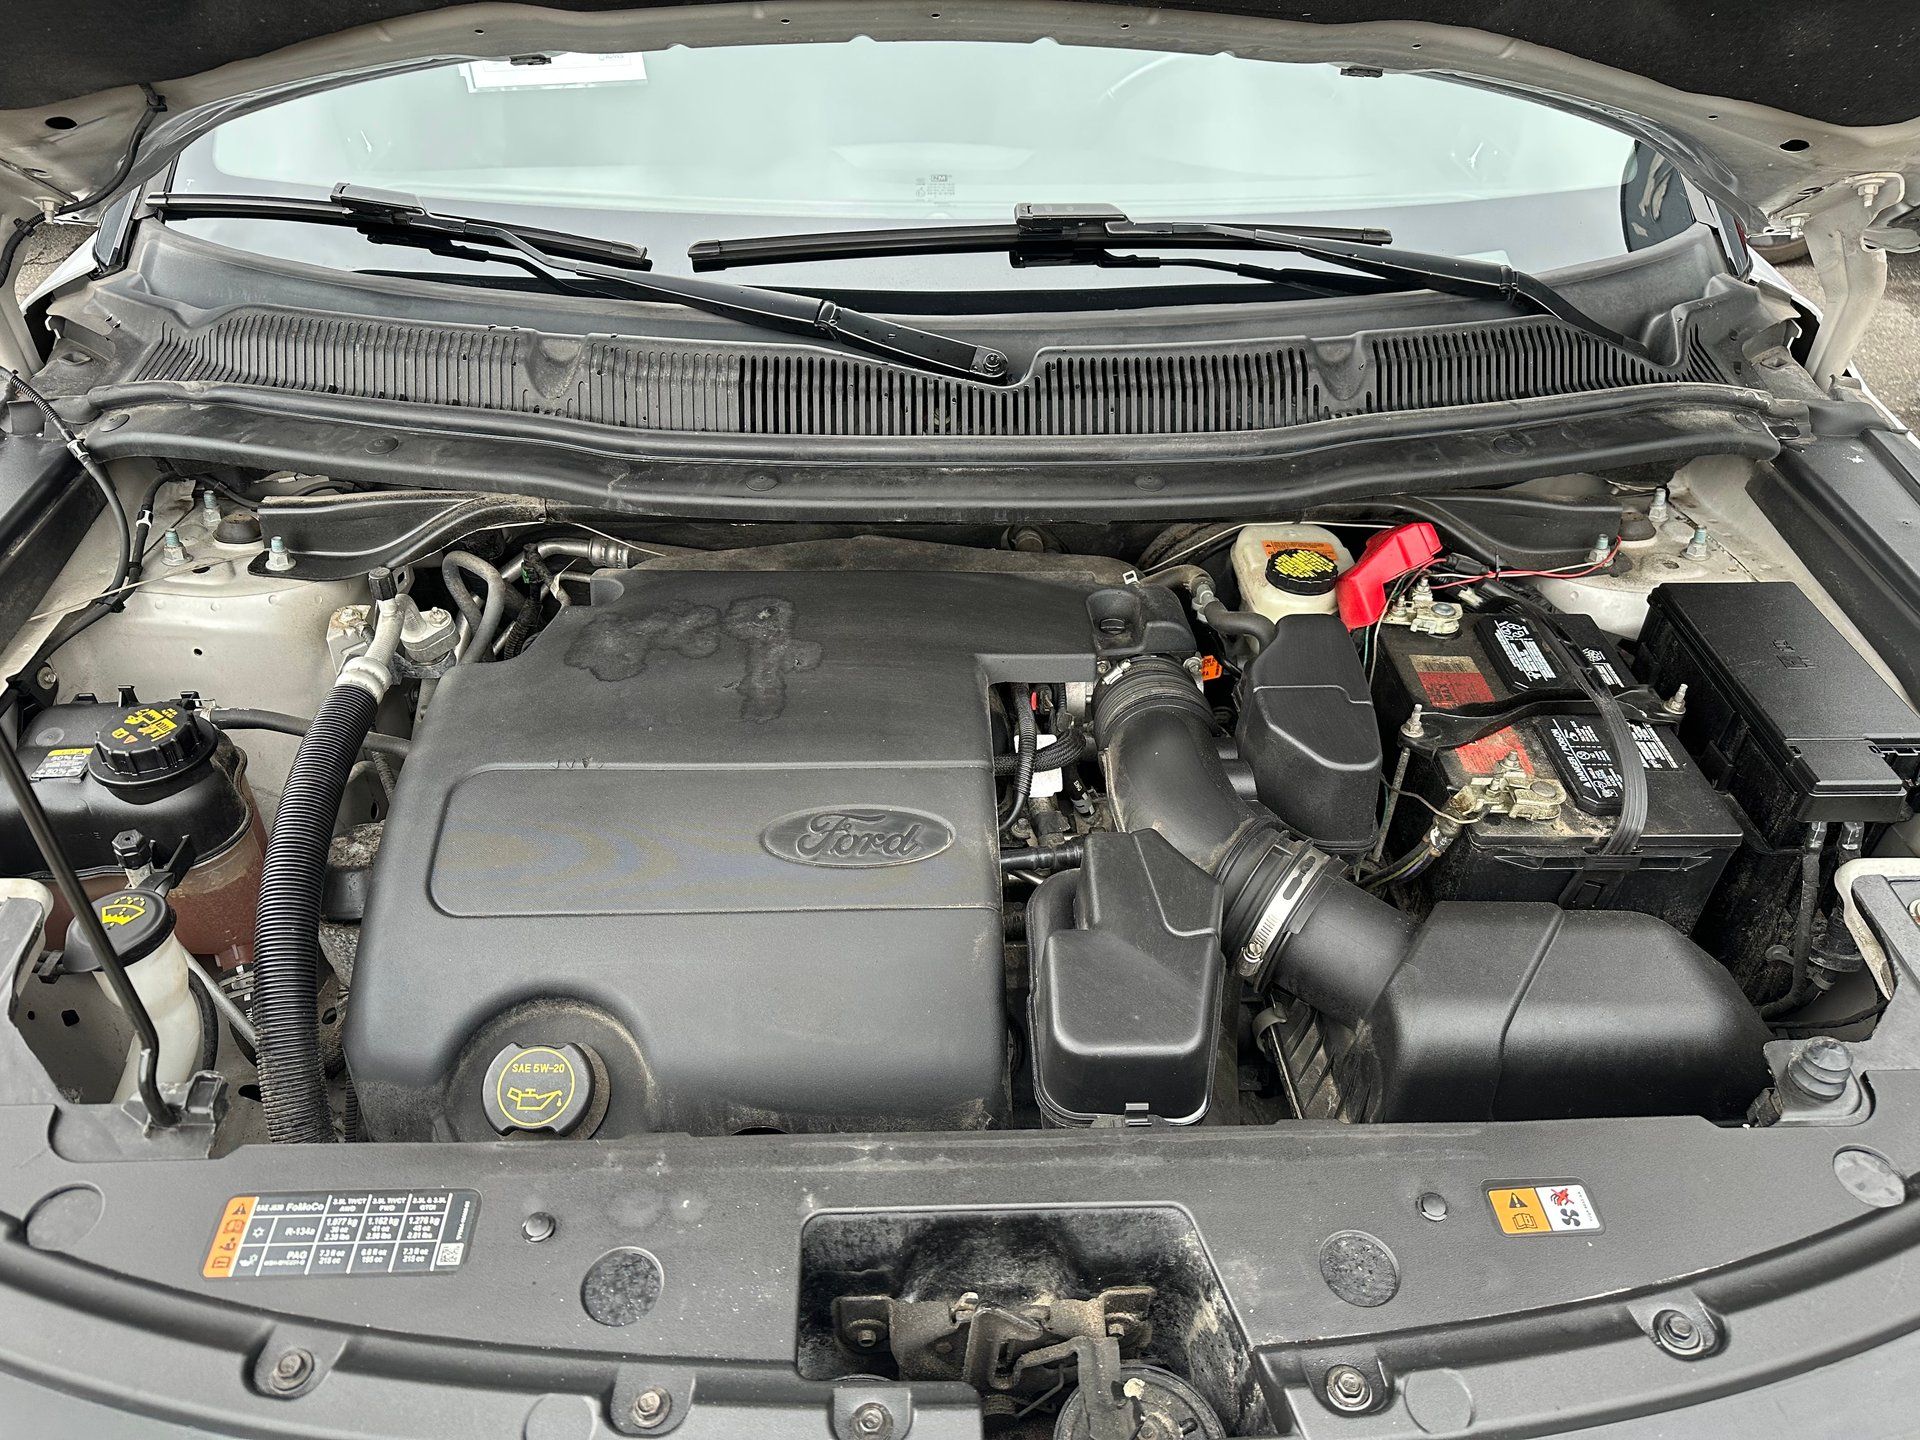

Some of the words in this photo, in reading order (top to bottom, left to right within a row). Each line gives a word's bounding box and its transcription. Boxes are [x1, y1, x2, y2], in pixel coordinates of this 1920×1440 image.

[1550, 729, 1570, 751] POISON
[1566, 756, 1588, 781] DANGER
[796, 814, 924, 857] Ford
[512, 1064, 531, 1073] SAE
[533, 1063, 565, 1073] 5W-20
[286, 1202, 324, 1212] FoMoCo
[347, 1218, 358, 1227] kg
[389, 1217, 400, 1226] kg
[430, 1217, 441, 1226] kg
[285, 1227, 316, 1236] R-134a
[287, 1251, 307, 1259] PAG
